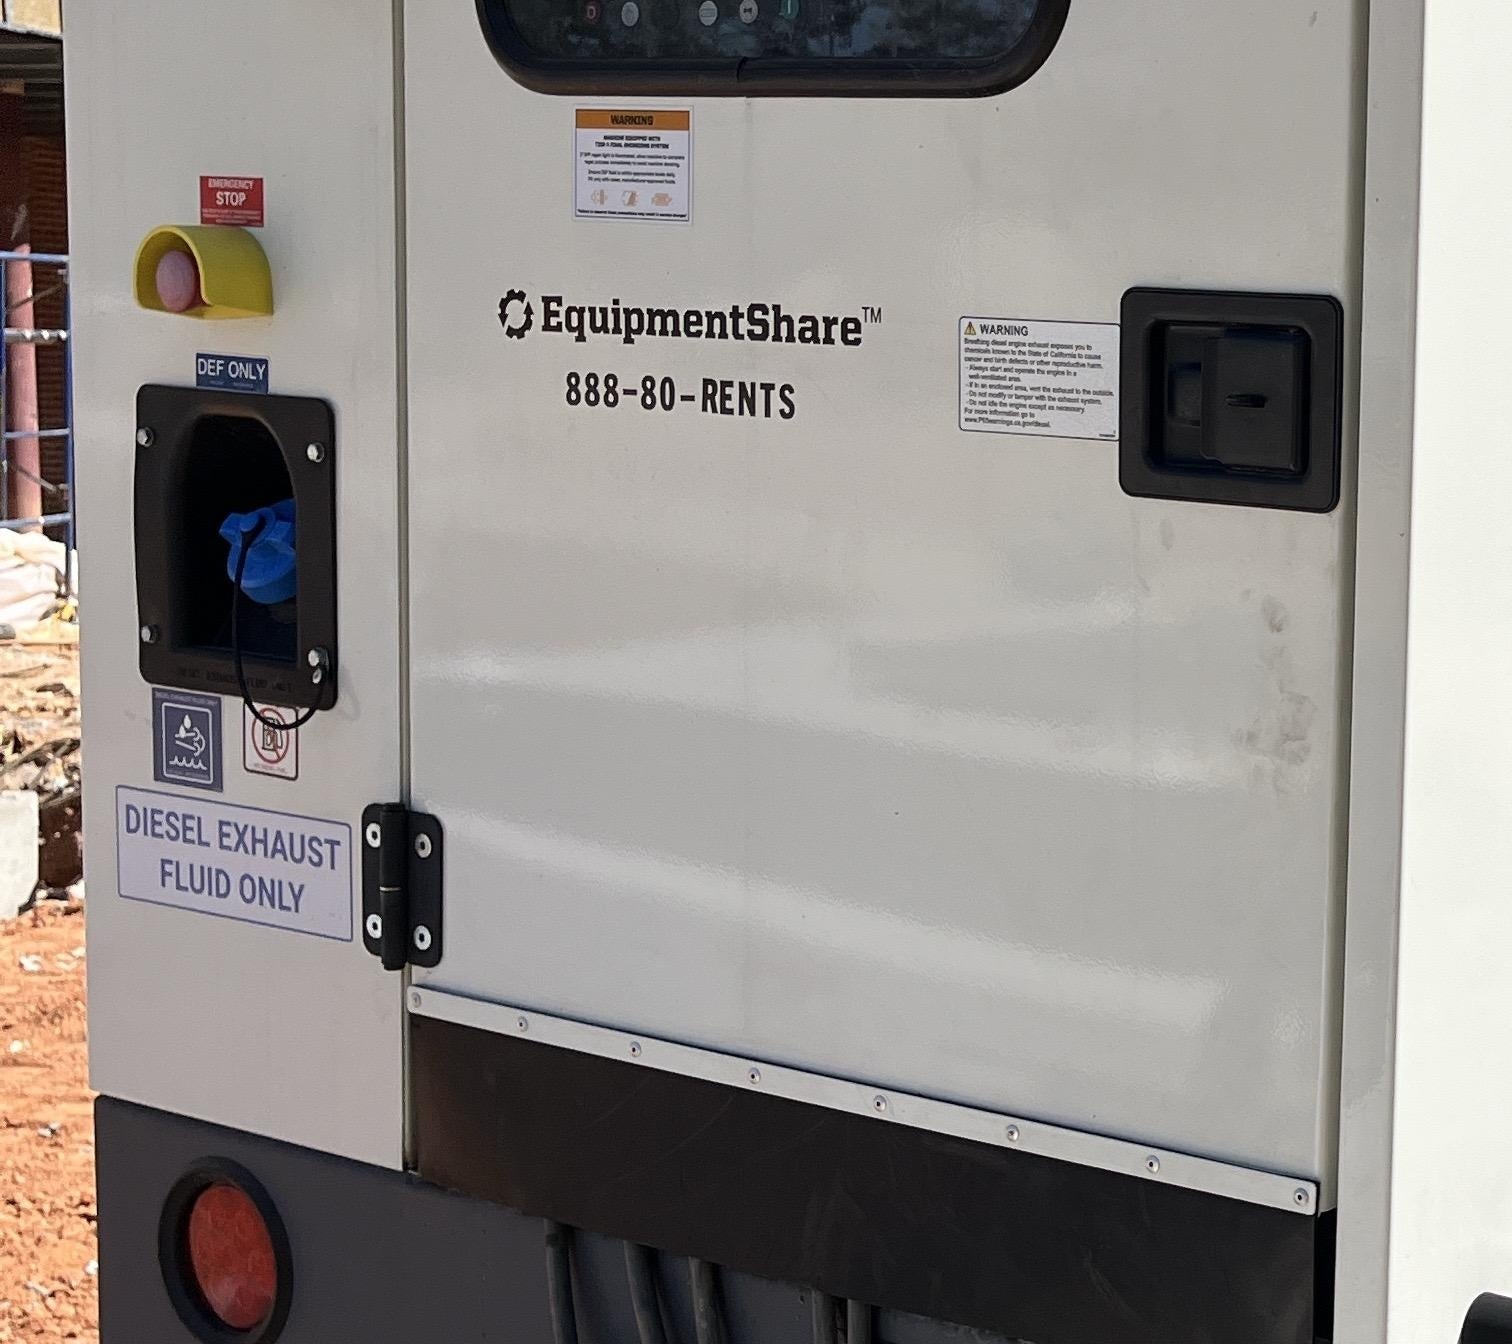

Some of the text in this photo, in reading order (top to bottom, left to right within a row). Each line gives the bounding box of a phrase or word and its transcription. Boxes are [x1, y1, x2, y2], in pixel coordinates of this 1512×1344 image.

[609, 114, 654, 126] WARNING
[207, 178, 254, 190] EMERGENCY
[215, 191, 247, 206] STOP
[541, 296, 863, 347] EquipmentShare
[979, 323, 1028, 336] WARNING
[197, 358, 266, 380] DEF ONLY
[565, 371, 796, 420] 888-80-RENTS
[124, 803, 342, 871] DIESEL EXHAUST
[160, 858, 305, 914] FLUID ONLY
